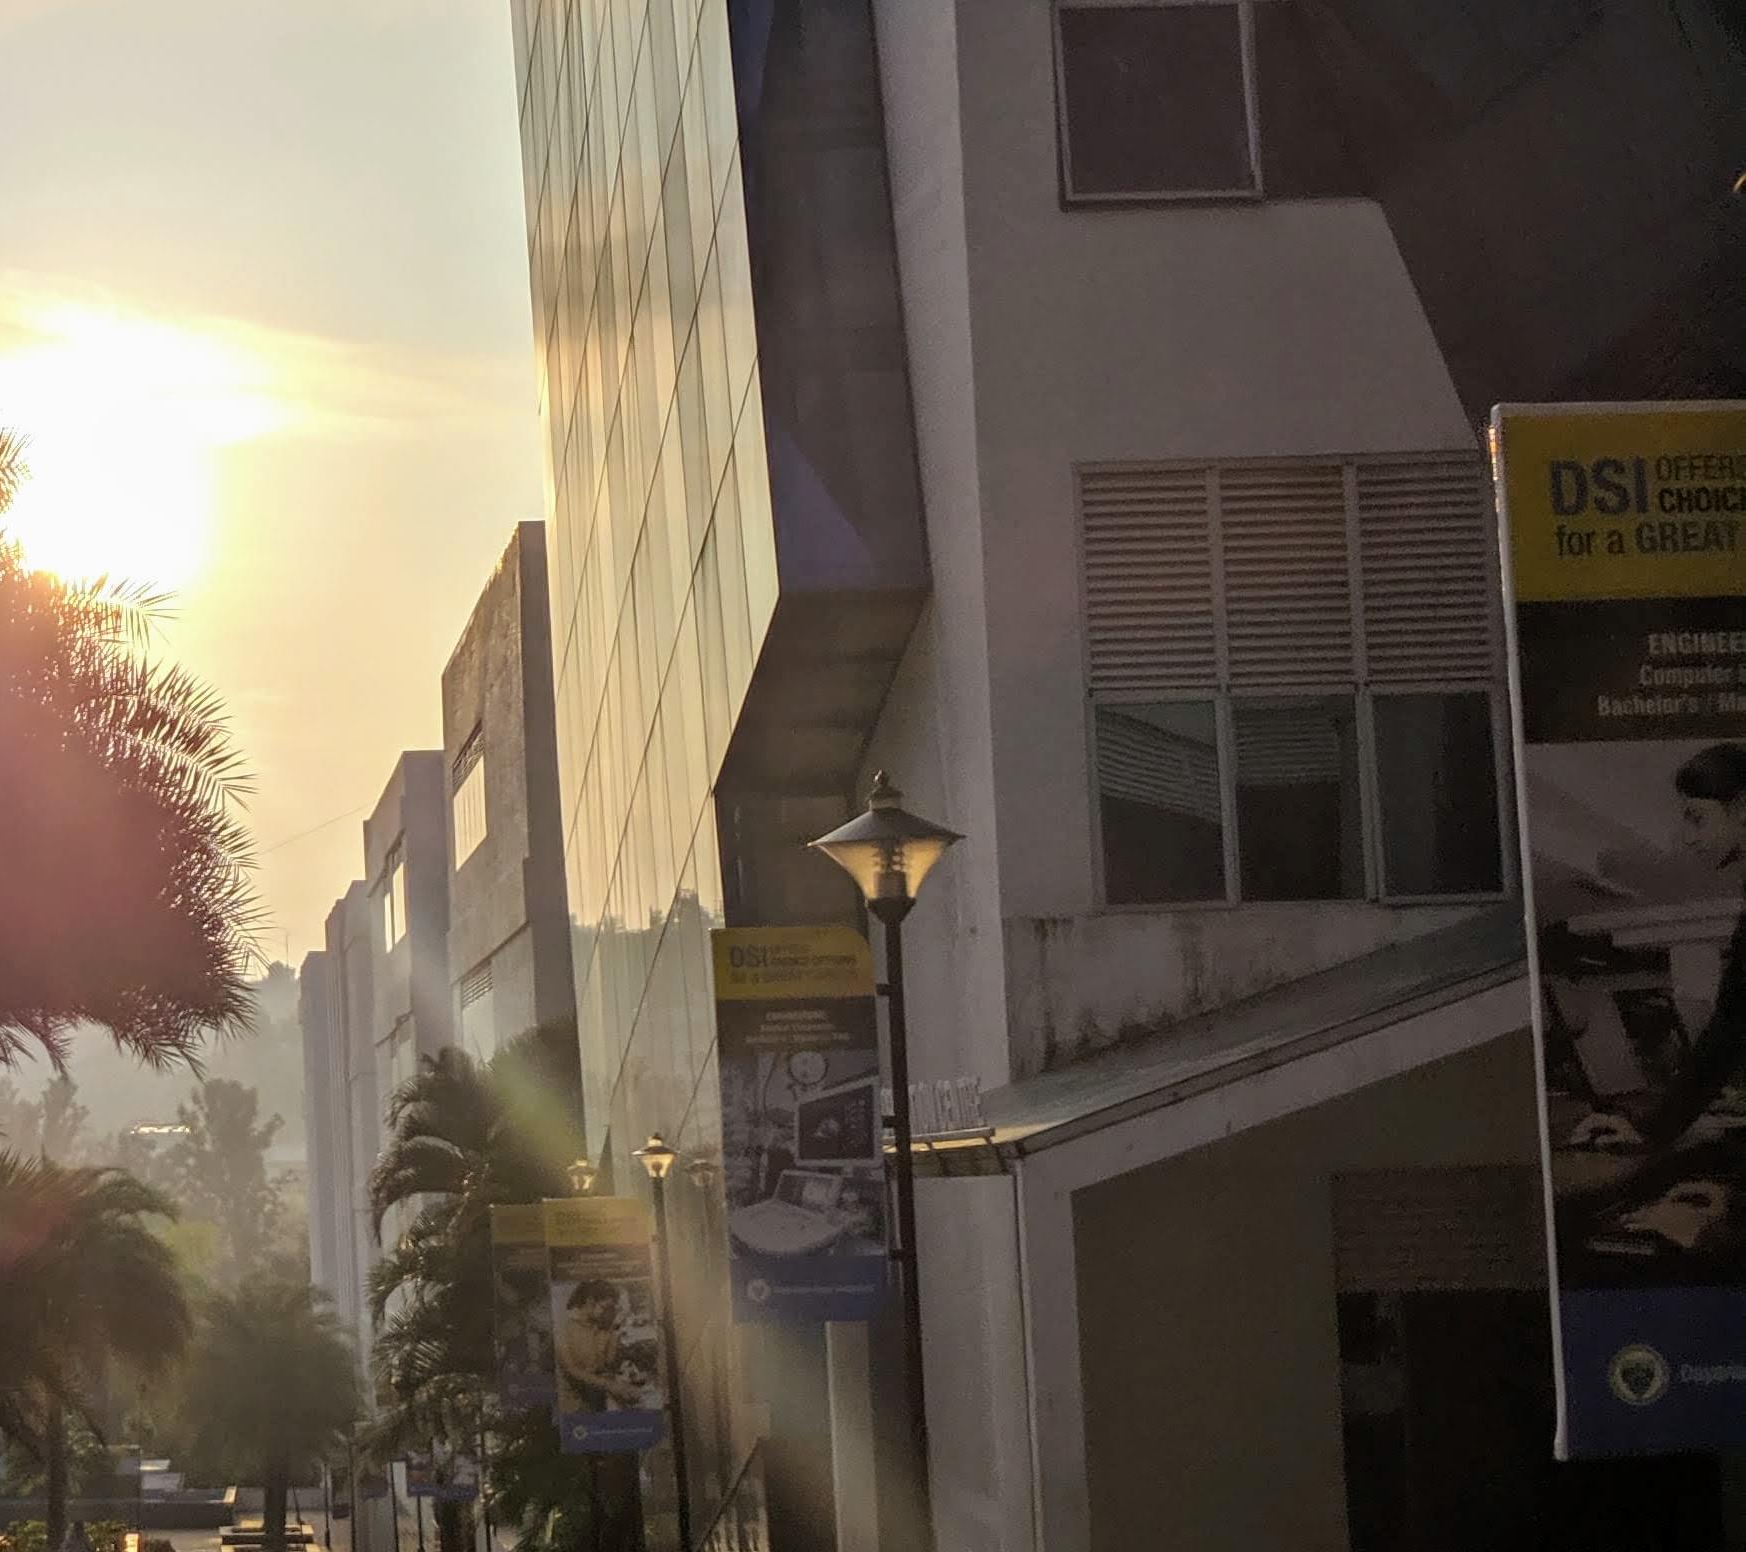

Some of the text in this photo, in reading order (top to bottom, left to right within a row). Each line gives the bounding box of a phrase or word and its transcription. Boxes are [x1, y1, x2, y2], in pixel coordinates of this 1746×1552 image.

[1550, 456, 1648, 515] DSI
[1556, 519, 1741, 557] for a GREAT
